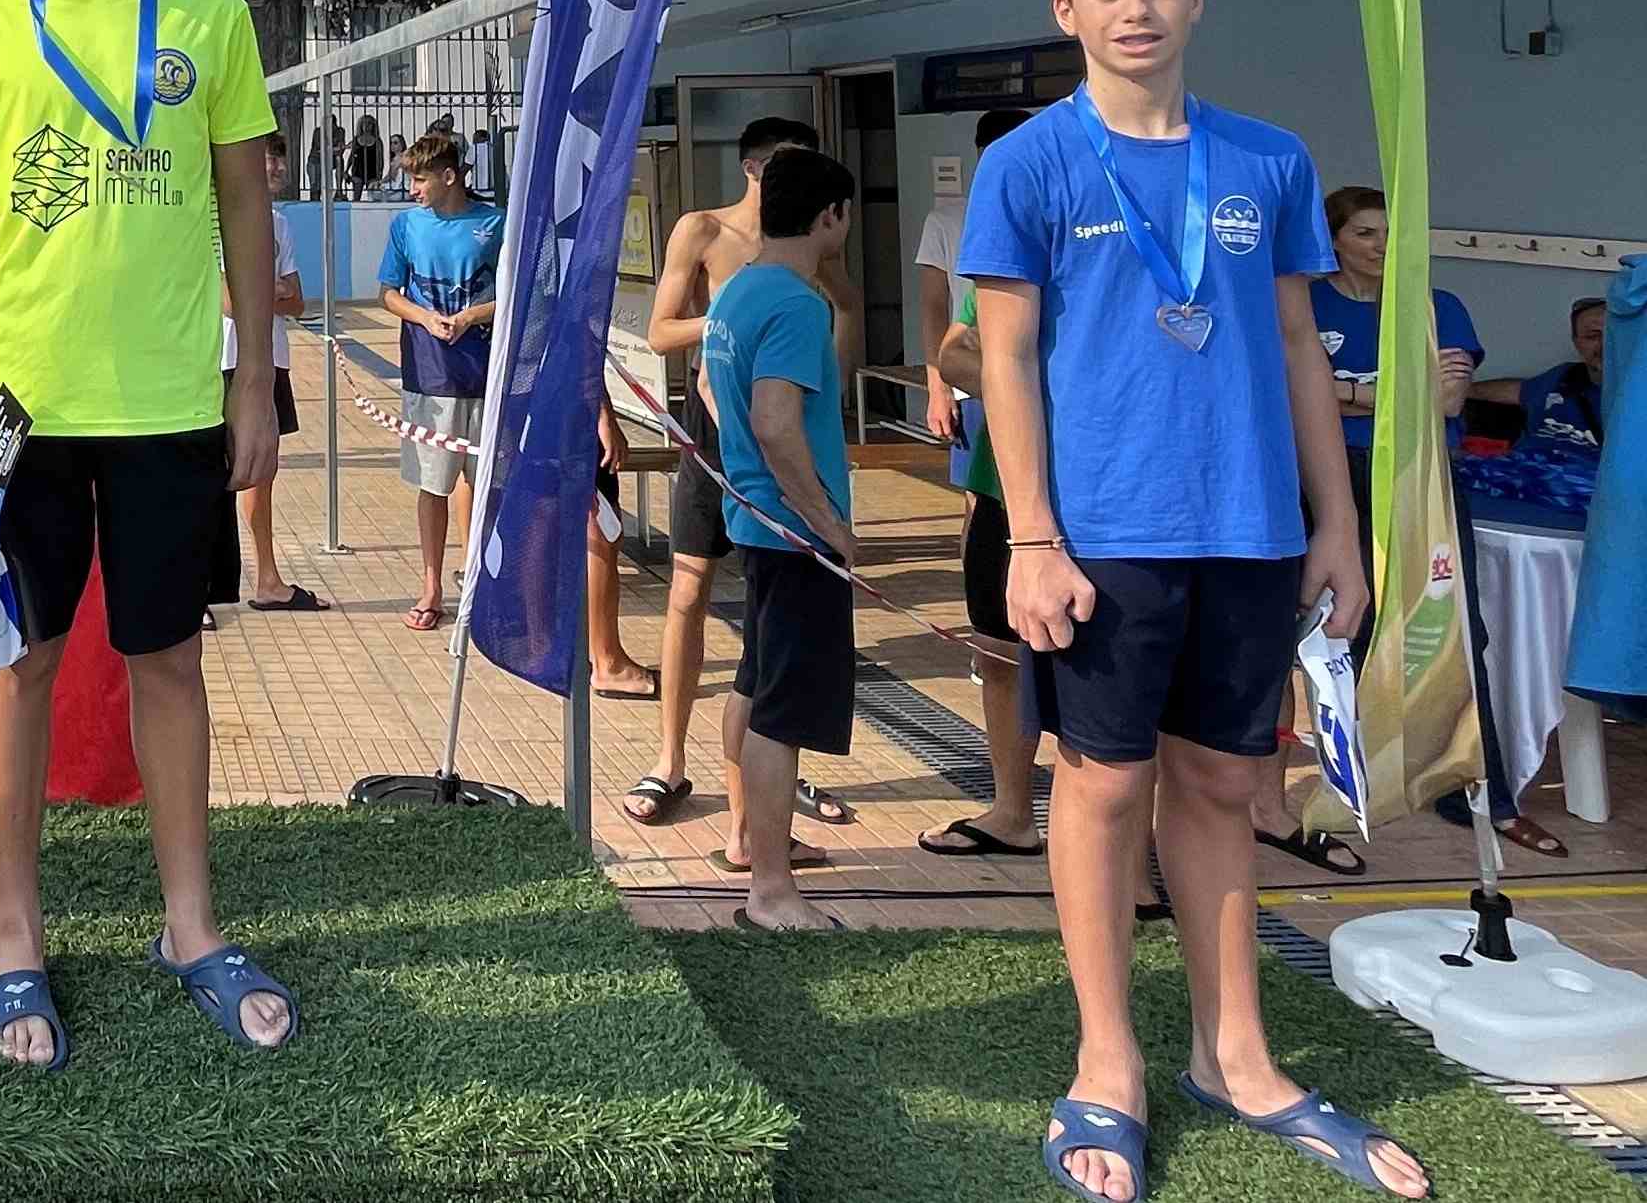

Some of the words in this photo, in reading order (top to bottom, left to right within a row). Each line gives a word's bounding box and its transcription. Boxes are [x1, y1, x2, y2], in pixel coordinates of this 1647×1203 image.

[105, 148, 172, 173] SANIKO
[104, 177, 170, 206] METAL
[1073, 219, 1152, 240] Speedle
